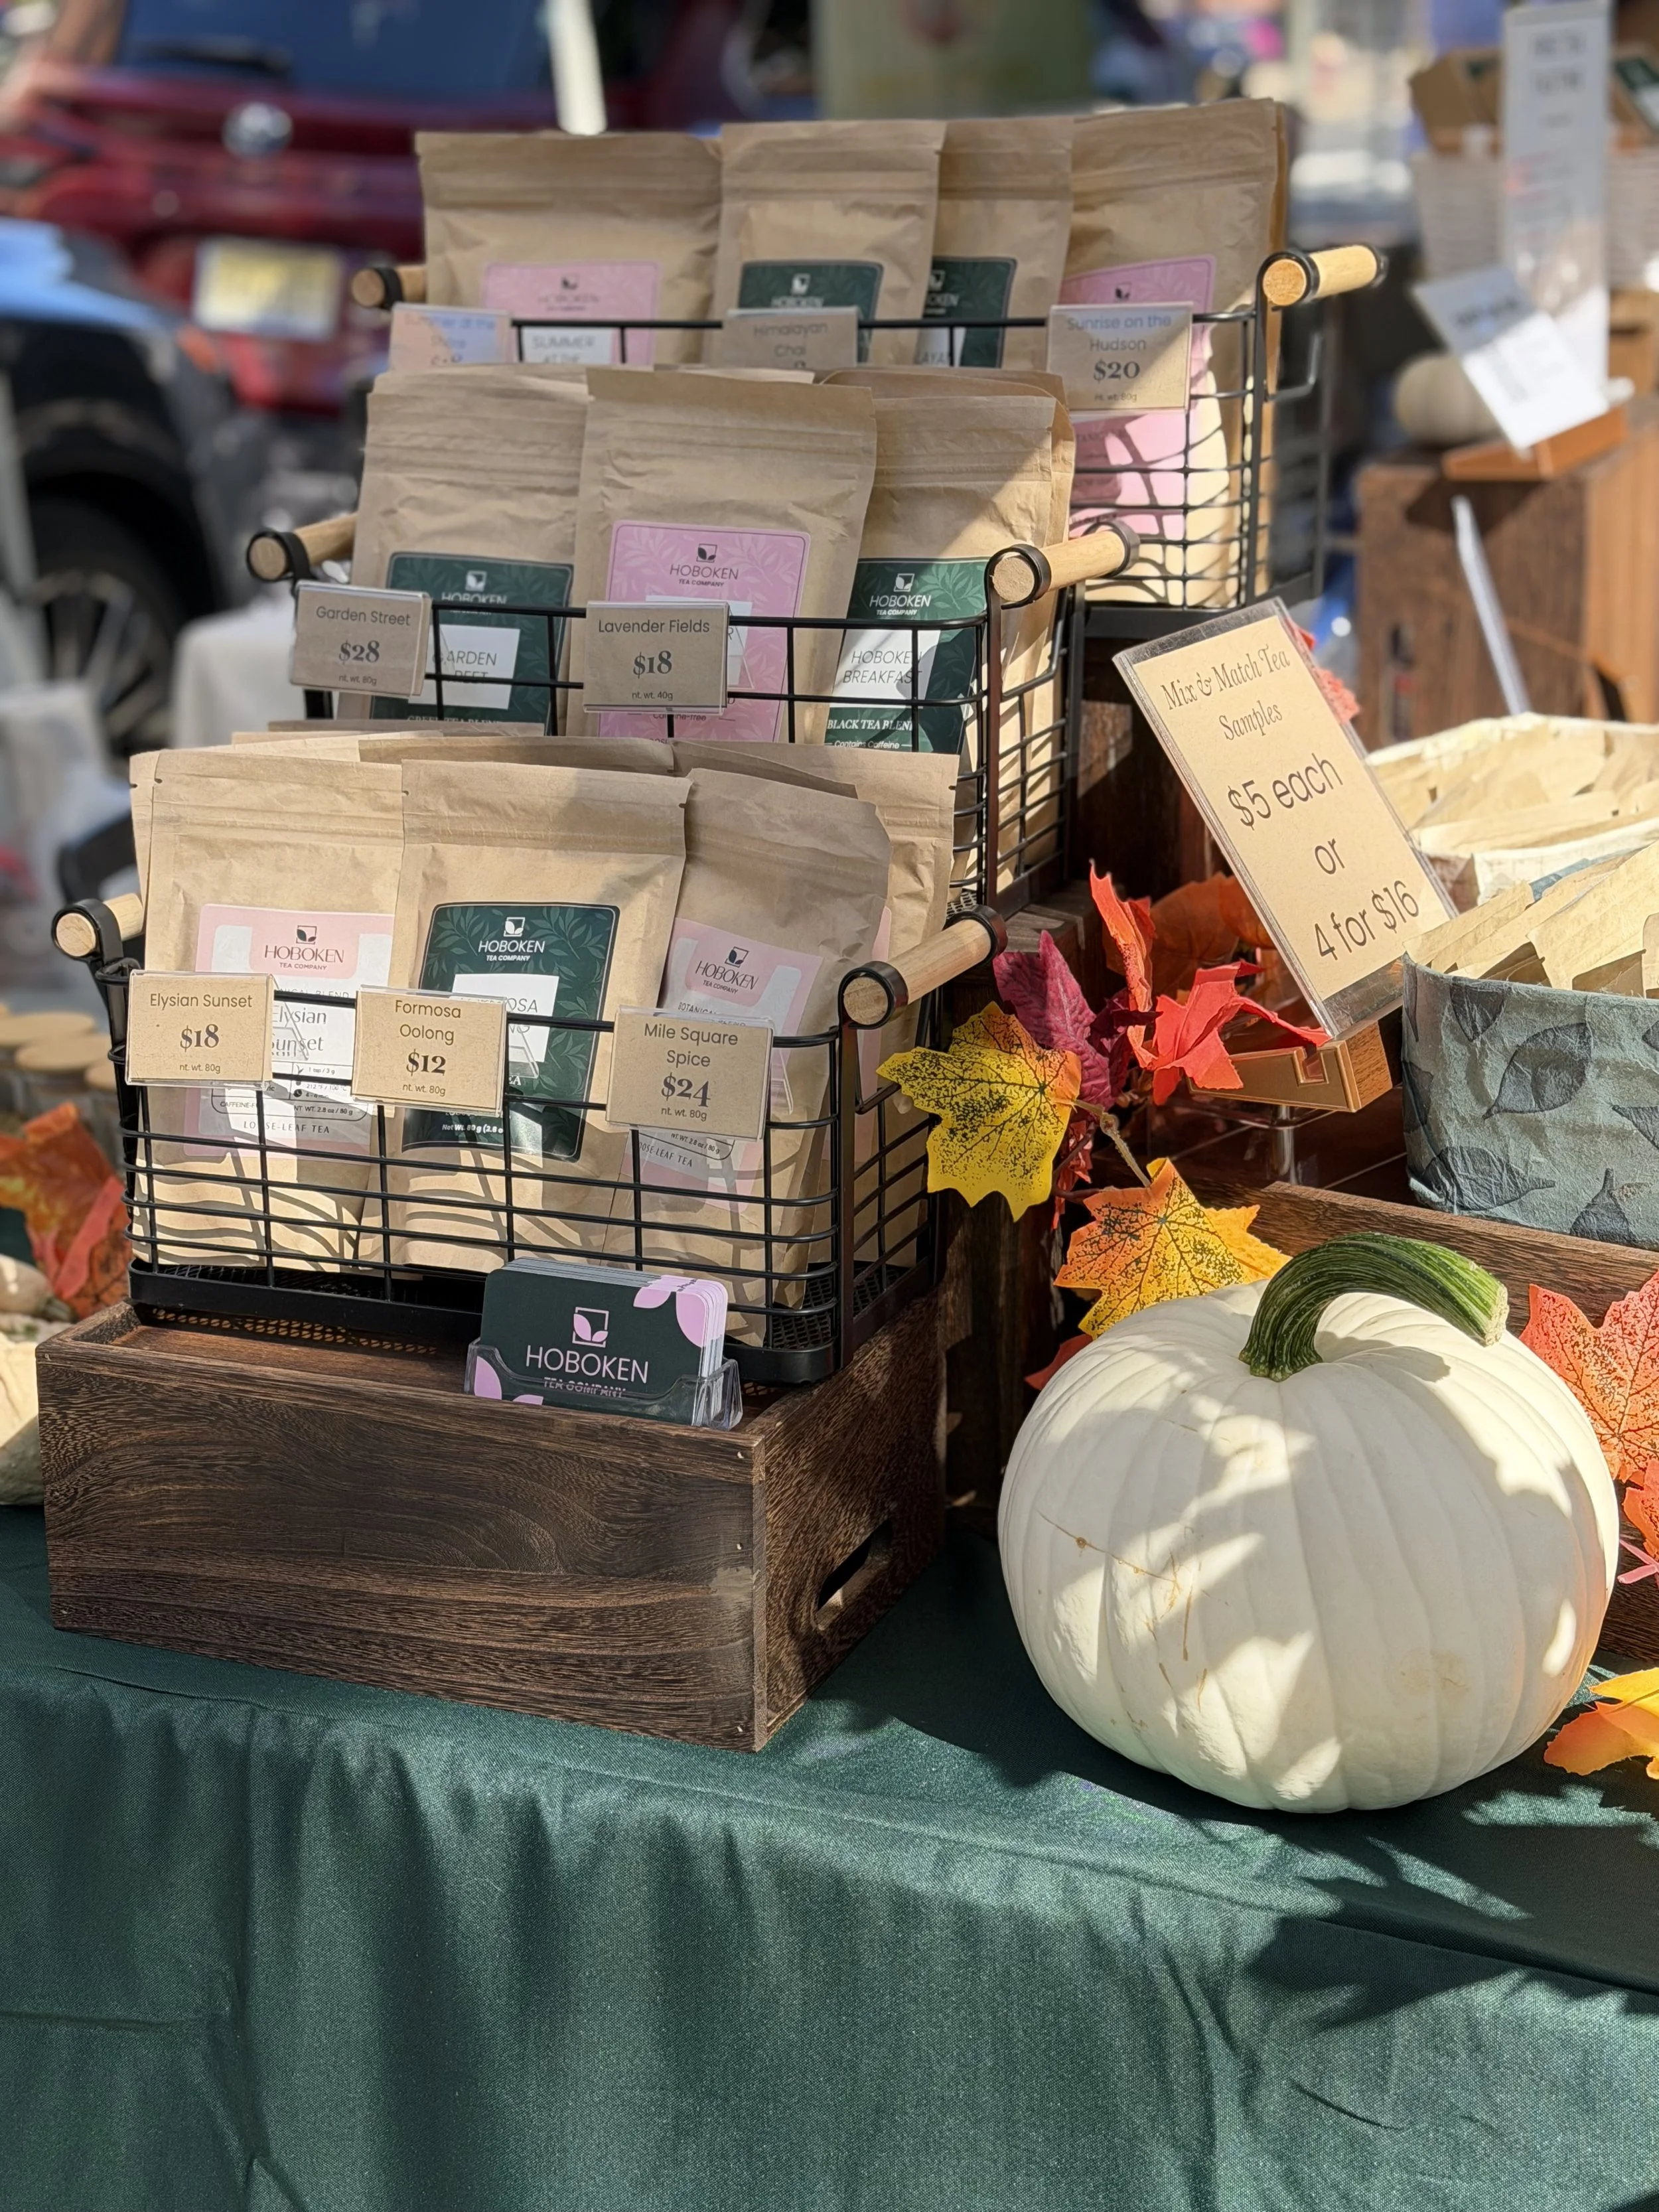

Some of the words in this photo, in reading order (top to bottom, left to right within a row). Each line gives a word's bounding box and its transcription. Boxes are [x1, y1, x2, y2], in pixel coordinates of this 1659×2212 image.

[753, 323, 829, 338] Himalayan
[1067, 317, 1121, 331] Sunrise
[1123, 317, 1143, 328] on
[1147, 314, 1172, 327] the
[774, 344, 806, 358] Chai
[1089, 338, 1147, 352] Hudson
[1093, 358, 1141, 383] $20
[670, 563, 739, 581] HOBOKEN
[691, 579, 724, 588] COMPANY
[869, 594, 932, 608] HOBOKEN
[315, 605, 366, 623] Garden
[370, 610, 411, 627] Street
[598, 619, 666, 633] Lavender
[668, 619, 711, 633] Fields
[338, 638, 381, 664] $28
[632, 649, 673, 679] $18
[1160, 674, 1197, 710] Mix
[1196, 672, 1213, 696] &
[1212, 653, 1262, 694] Match
[1258, 644, 1291, 676] Tea
[657, 691, 674, 701] 40g
[827, 719, 859, 730] BLACK
[860, 719, 881, 729] TEA
[881, 719, 912, 731] BLEN
[1219, 700, 1283, 741] Samples
[834, 739, 866, 749] Contains
[867, 741, 900, 749] Caffeine
[1227, 779, 1271, 831] $5
[1273, 753, 1344, 809] each
[1314, 838, 1345, 875] or
[1315, 922, 1338, 961] 4
[1331, 912, 1376, 953] for
[1370, 879, 1420, 934] $16
[264, 944, 344, 964] HOBOKEN
[478, 939, 545, 954] HOBOKEN
[694, 960, 760, 991] HOBOKEN
[703, 979, 713, 988] TEA
[713, 981, 739, 995] COMPANY
[149, 993, 198, 1011] Elysian
[203, 994, 253, 1009] Sunset
[395, 999, 461, 1019] Formosa
[179, 1023, 220, 1053] $18
[399, 1023, 455, 1046] Oolong
[644, 1023, 676, 1040] Mile
[680, 1026, 739, 1047] Square
[405, 1049, 447, 1077] $12
[666, 1049, 711, 1068] Spice
[204, 1063, 221, 1074] 80g
[429, 1084, 447, 1097] 80g
[660, 1072, 711, 1108] $24
[689, 1109, 707, 1122] 80g
[244, 1120, 307, 1132] LOSE-LEAF
[311, 1124, 330, 1134] TEA
[638, 1142, 674, 1160] OOSE-LEAF
[678, 1154, 693, 1167] TEA
[525, 1345, 649, 1384] HOBOKEN
